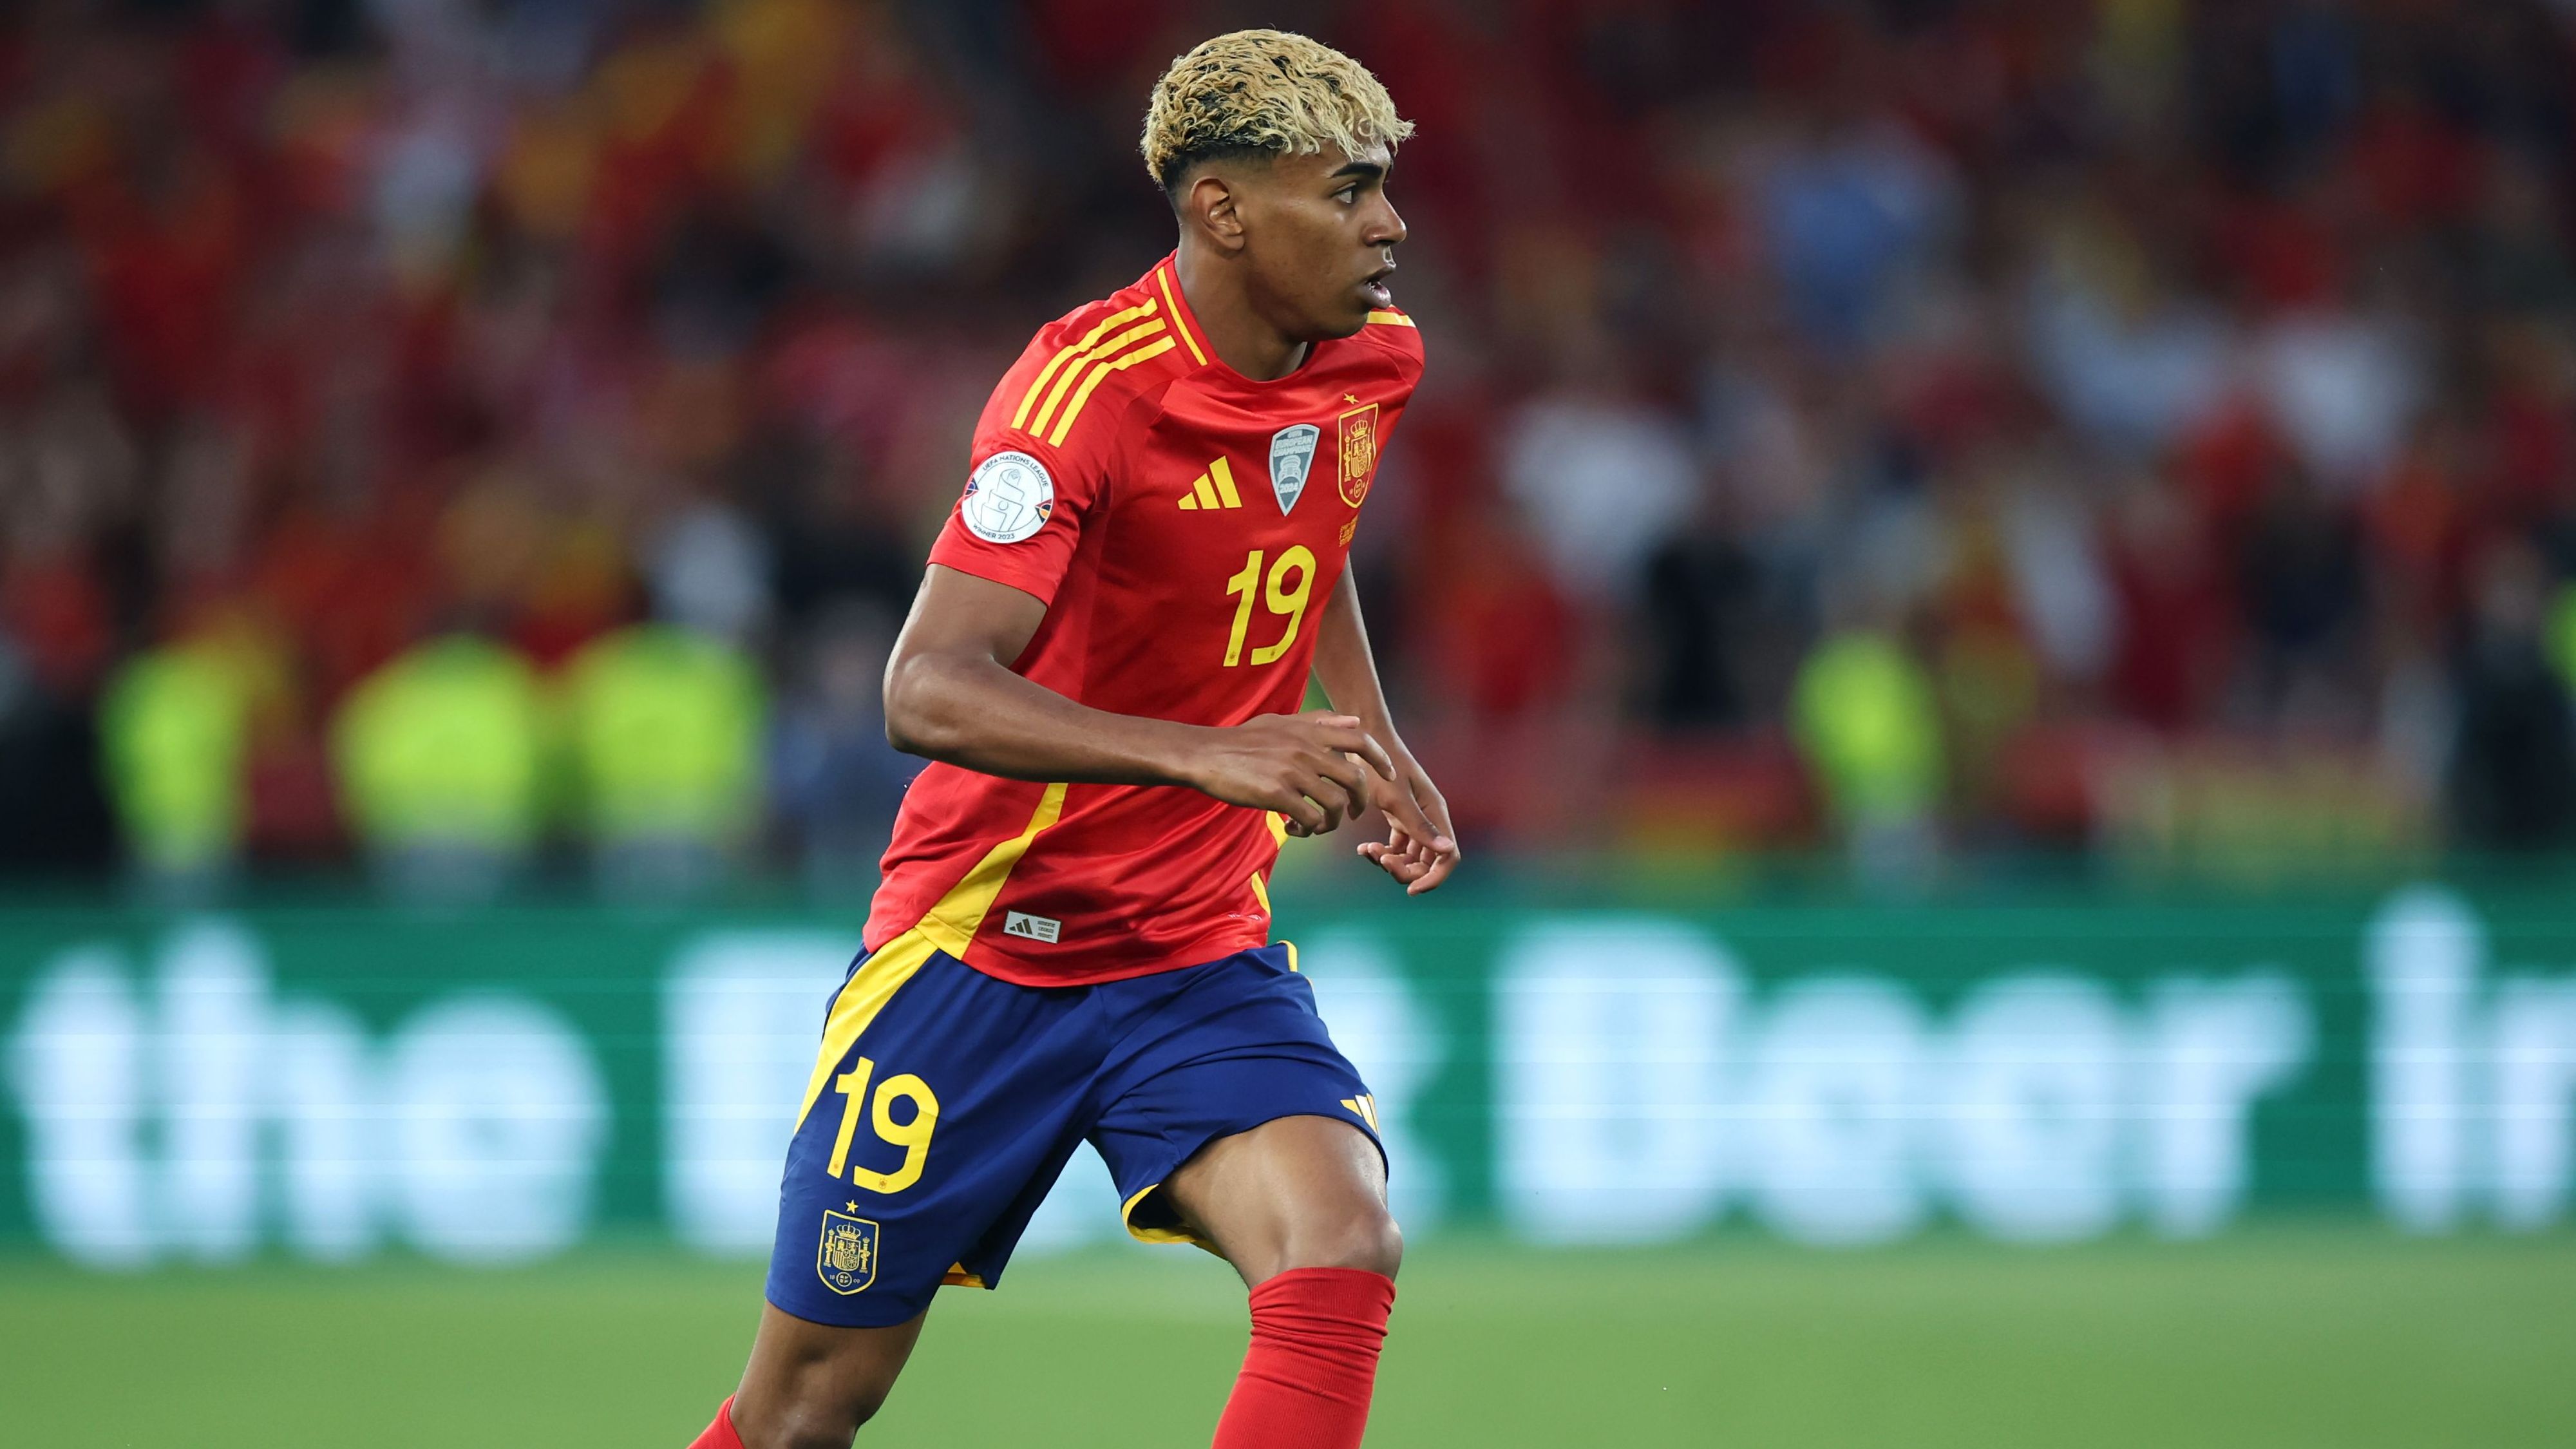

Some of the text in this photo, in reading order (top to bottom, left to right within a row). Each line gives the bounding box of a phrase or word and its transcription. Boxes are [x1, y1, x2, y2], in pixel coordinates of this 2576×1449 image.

[982, 455, 1049, 488] UEFA NATIONS LEAGUE
[1280, 482, 1299, 494] 2024
[973, 523, 996, 539] WINNER
[1224, 545, 1316, 666] 19
[16, 921, 607, 1264] the
[1497, 920, 2312, 1243] Beer
[827, 1056, 940, 1194] 19
